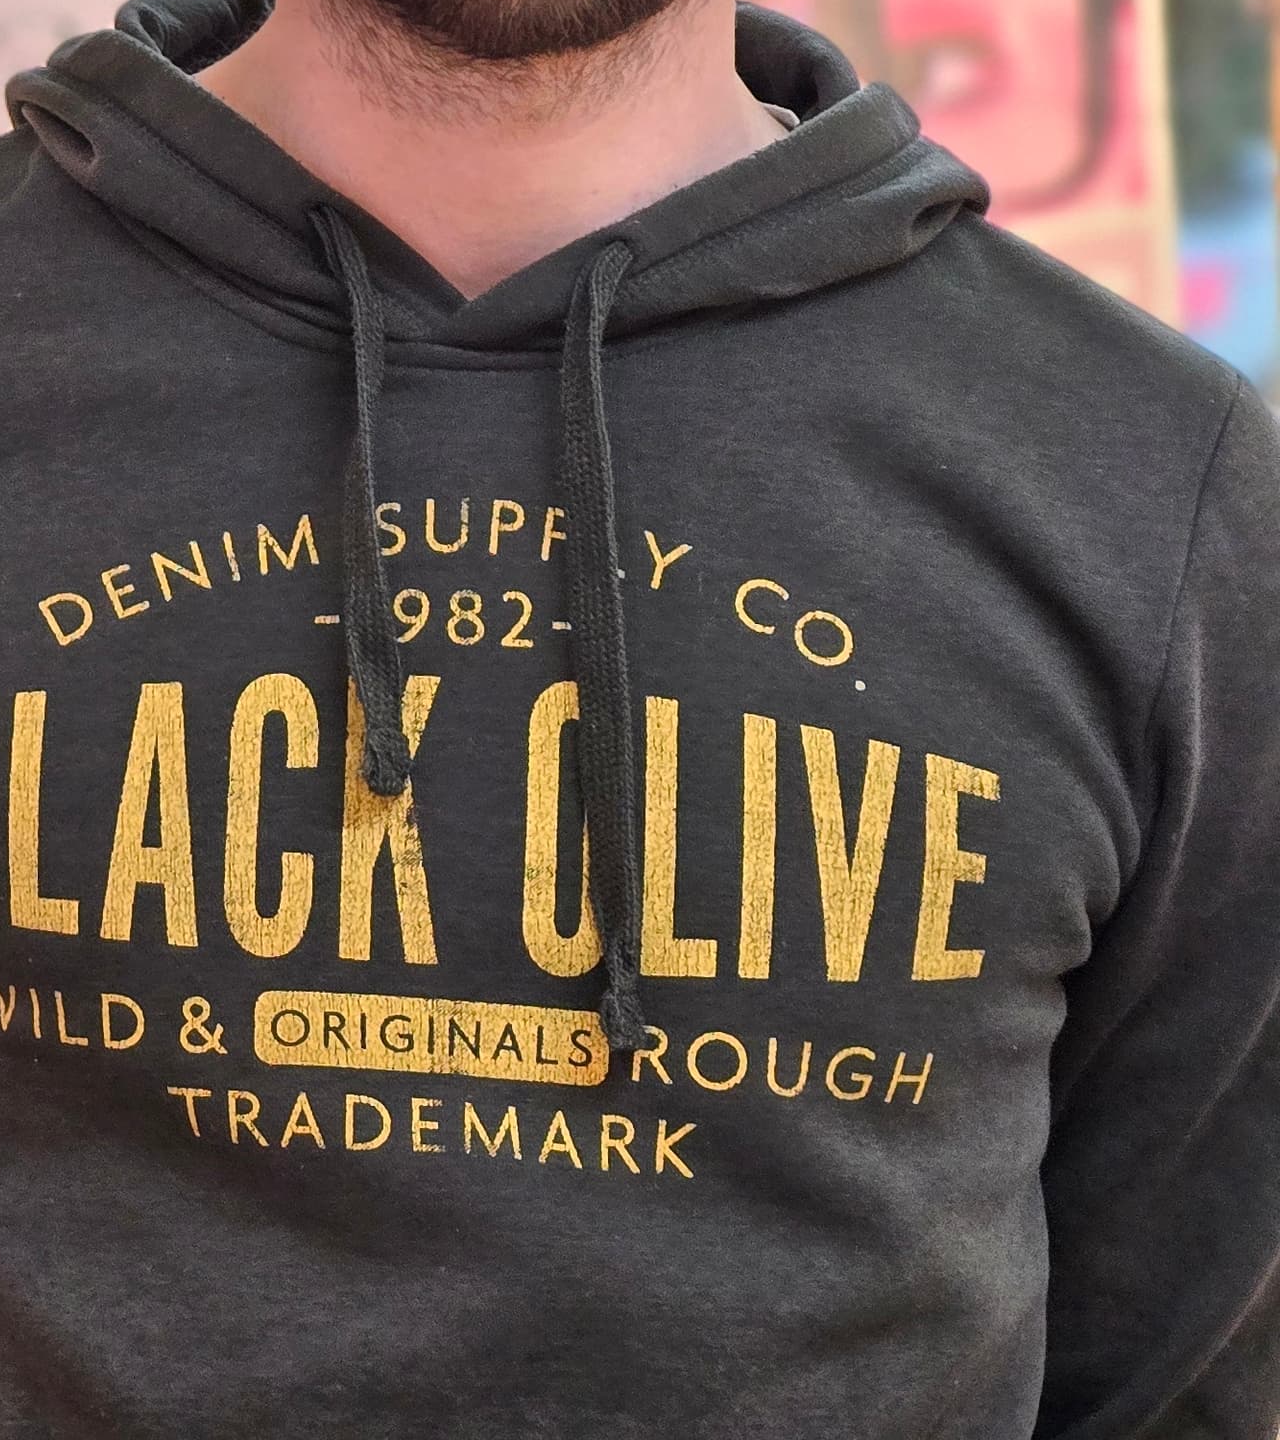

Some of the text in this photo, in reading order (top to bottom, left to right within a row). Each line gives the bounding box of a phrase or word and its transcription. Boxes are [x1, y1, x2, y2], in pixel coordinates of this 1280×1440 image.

[38, 498, 866, 691] DENIM SUPPY CO.
[313, 588, 572, 649] -982-
[522, 680, 1001, 983] OLIVE
[179, 995, 228, 1055] &
[269, 1009, 594, 1068] ORIGINALS
[630, 1025, 934, 1105] ROUGH
[167, 1086, 697, 1179] TRADEMARK
